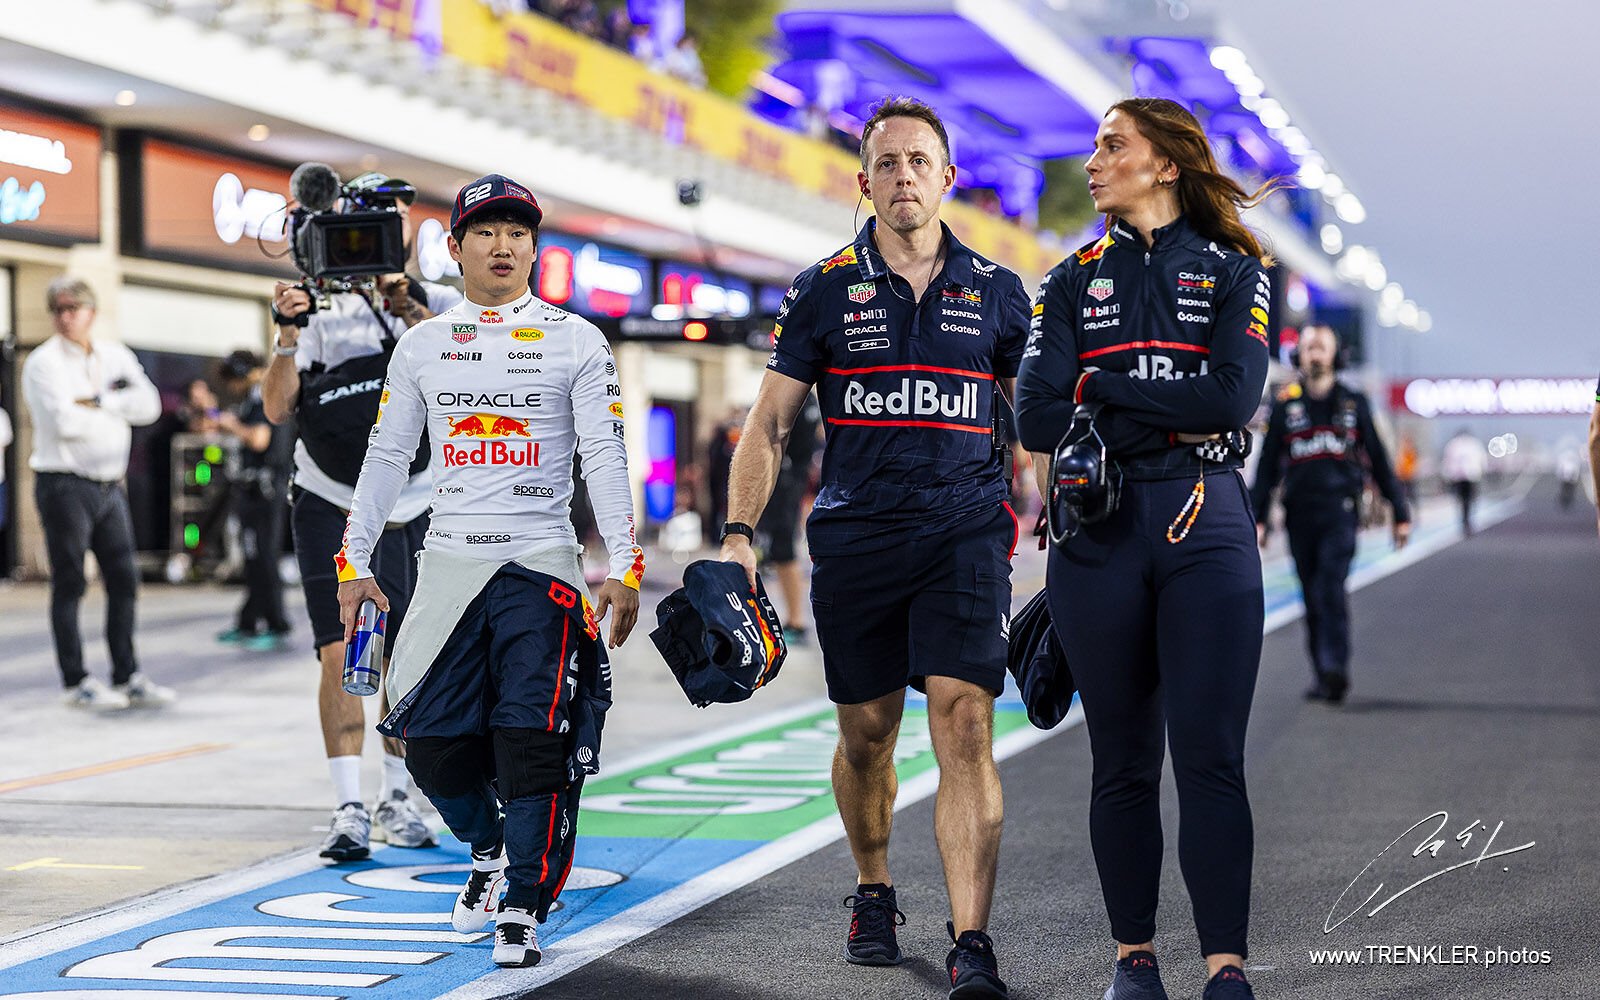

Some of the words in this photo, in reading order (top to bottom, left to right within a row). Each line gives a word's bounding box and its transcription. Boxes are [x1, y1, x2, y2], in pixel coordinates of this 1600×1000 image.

[465, 183, 492, 207] 22
[851, 283, 873, 294] TAG
[850, 290, 875, 302] HEUER
[844, 310, 874, 323] Mobil
[875, 308, 887, 319] 1
[941, 309, 983, 320] HONDA
[1083, 305, 1109, 318] Mobil
[1110, 303, 1120, 315] 1
[1186, 313, 1209, 323] Gate
[454, 325, 475, 333] TAG
[844, 324, 888, 335] ORACLE
[950, 323, 981, 336] Gate.io
[1084, 318, 1120, 330] ORACLE
[453, 333, 477, 342] HEUER
[519, 331, 541, 339] RAUCH
[441, 352, 470, 361] Mobil
[472, 352, 482, 361] 1
[516, 351, 543, 360] Gate
[606, 384, 621, 396] RO
[436, 392, 542, 407] ORACLE
[844, 378, 909, 416] Red
[914, 379, 979, 419] Bull
[443, 441, 486, 468] Red
[491, 442, 540, 467] Bull
[446, 486, 464, 494] YUKI
[513, 484, 554, 498] sparco
[435, 531, 452, 539] YUKI
[466, 534, 511, 544] sparco
